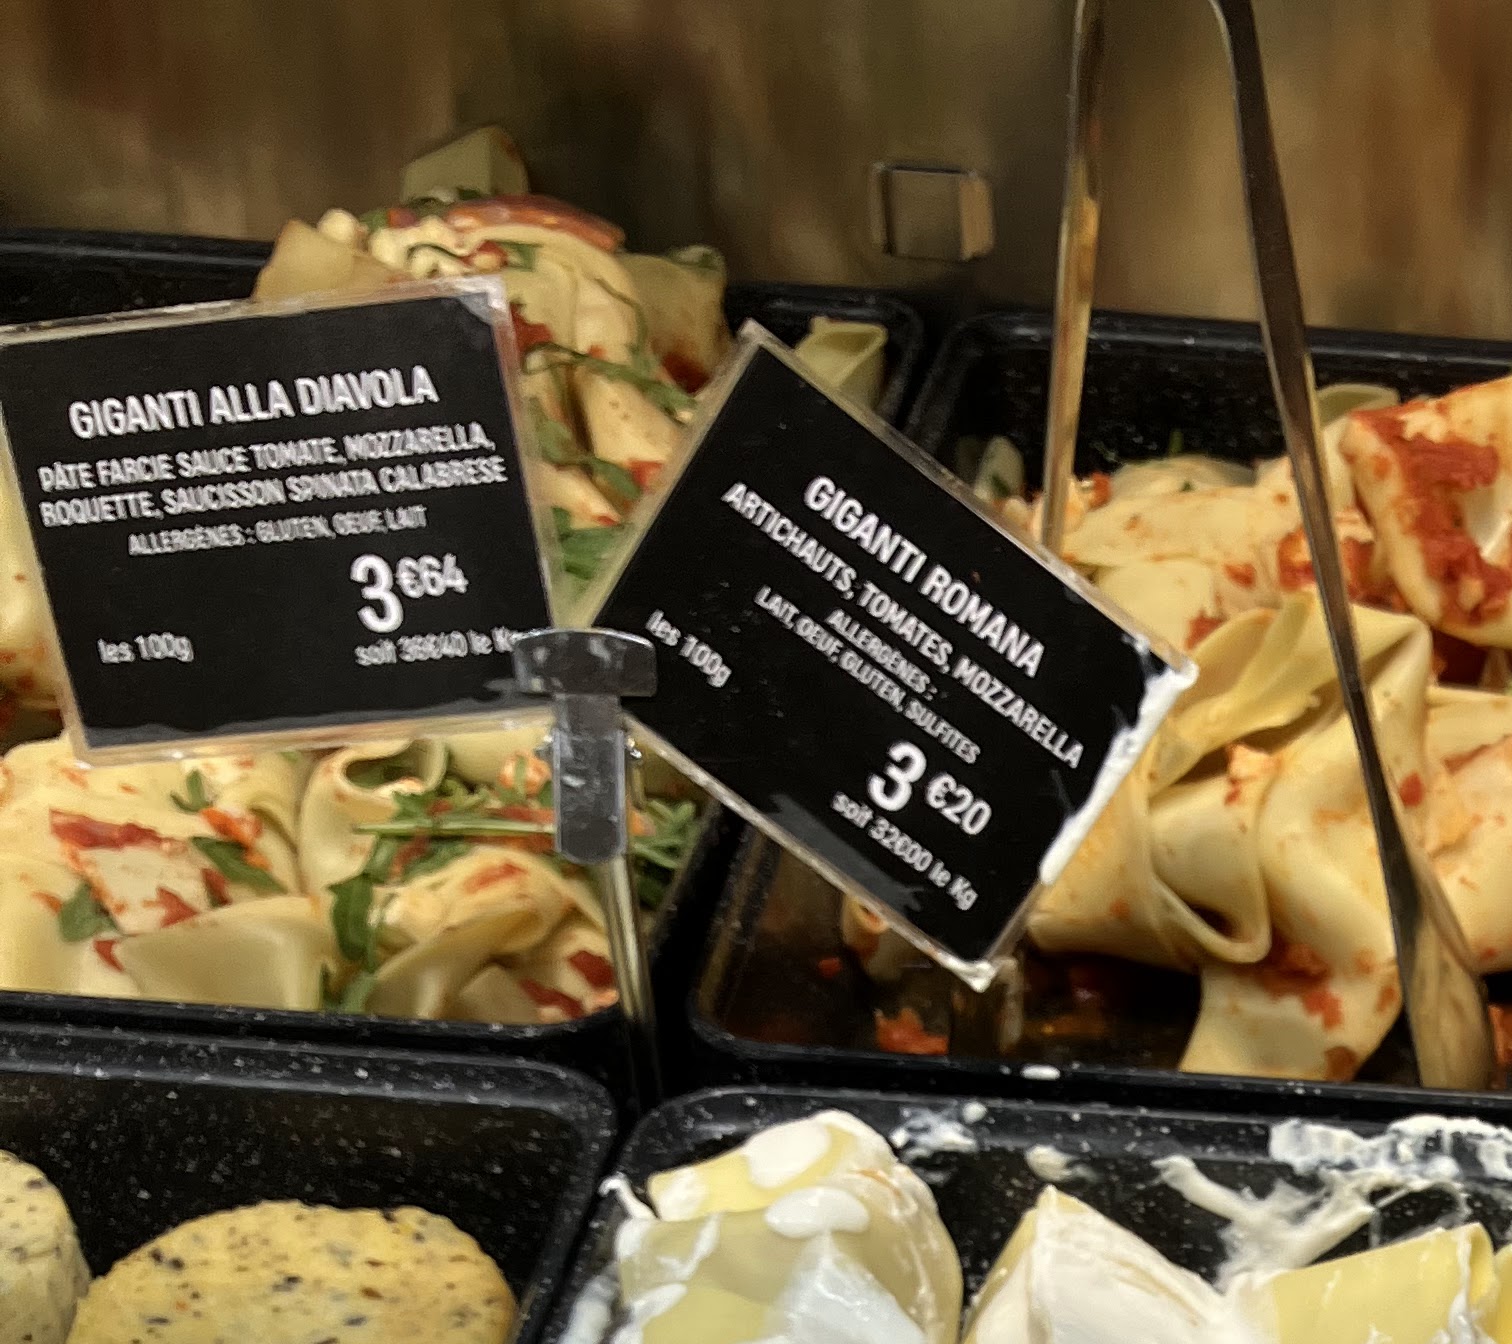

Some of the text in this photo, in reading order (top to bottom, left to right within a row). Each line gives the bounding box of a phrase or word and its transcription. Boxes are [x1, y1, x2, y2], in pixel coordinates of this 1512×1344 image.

[69, 365, 439, 439] GIGANTI ALLA DIAVOLA
[39, 491, 165, 527] ROQUETTE,
[160, 478, 286, 515] SAUCISSON
[377, 455, 509, 493] CALABRESE
[95, 453, 177, 486] FARCIE
[175, 446, 252, 478] SAUCE
[248, 437, 347, 470] TOMATE,
[342, 421, 497, 461] MOZZARELLA,
[803, 475, 1046, 679] GIGANTI ROMANA
[97, 631, 194, 664] les 100g
[354, 638, 398, 667] soit
[466, 629, 494, 656] le
[645, 609, 733, 688] les 100g
[720, 481, 1085, 770] ARTICHAUTS, TOMATES, MOZZARELLA
[753, 584, 800, 630] LAIT,
[838, 650, 907, 713] GLUTEN,
[902, 698, 982, 765] SULFITES
[829, 790, 980, 911] soit 32€00 le Kg
